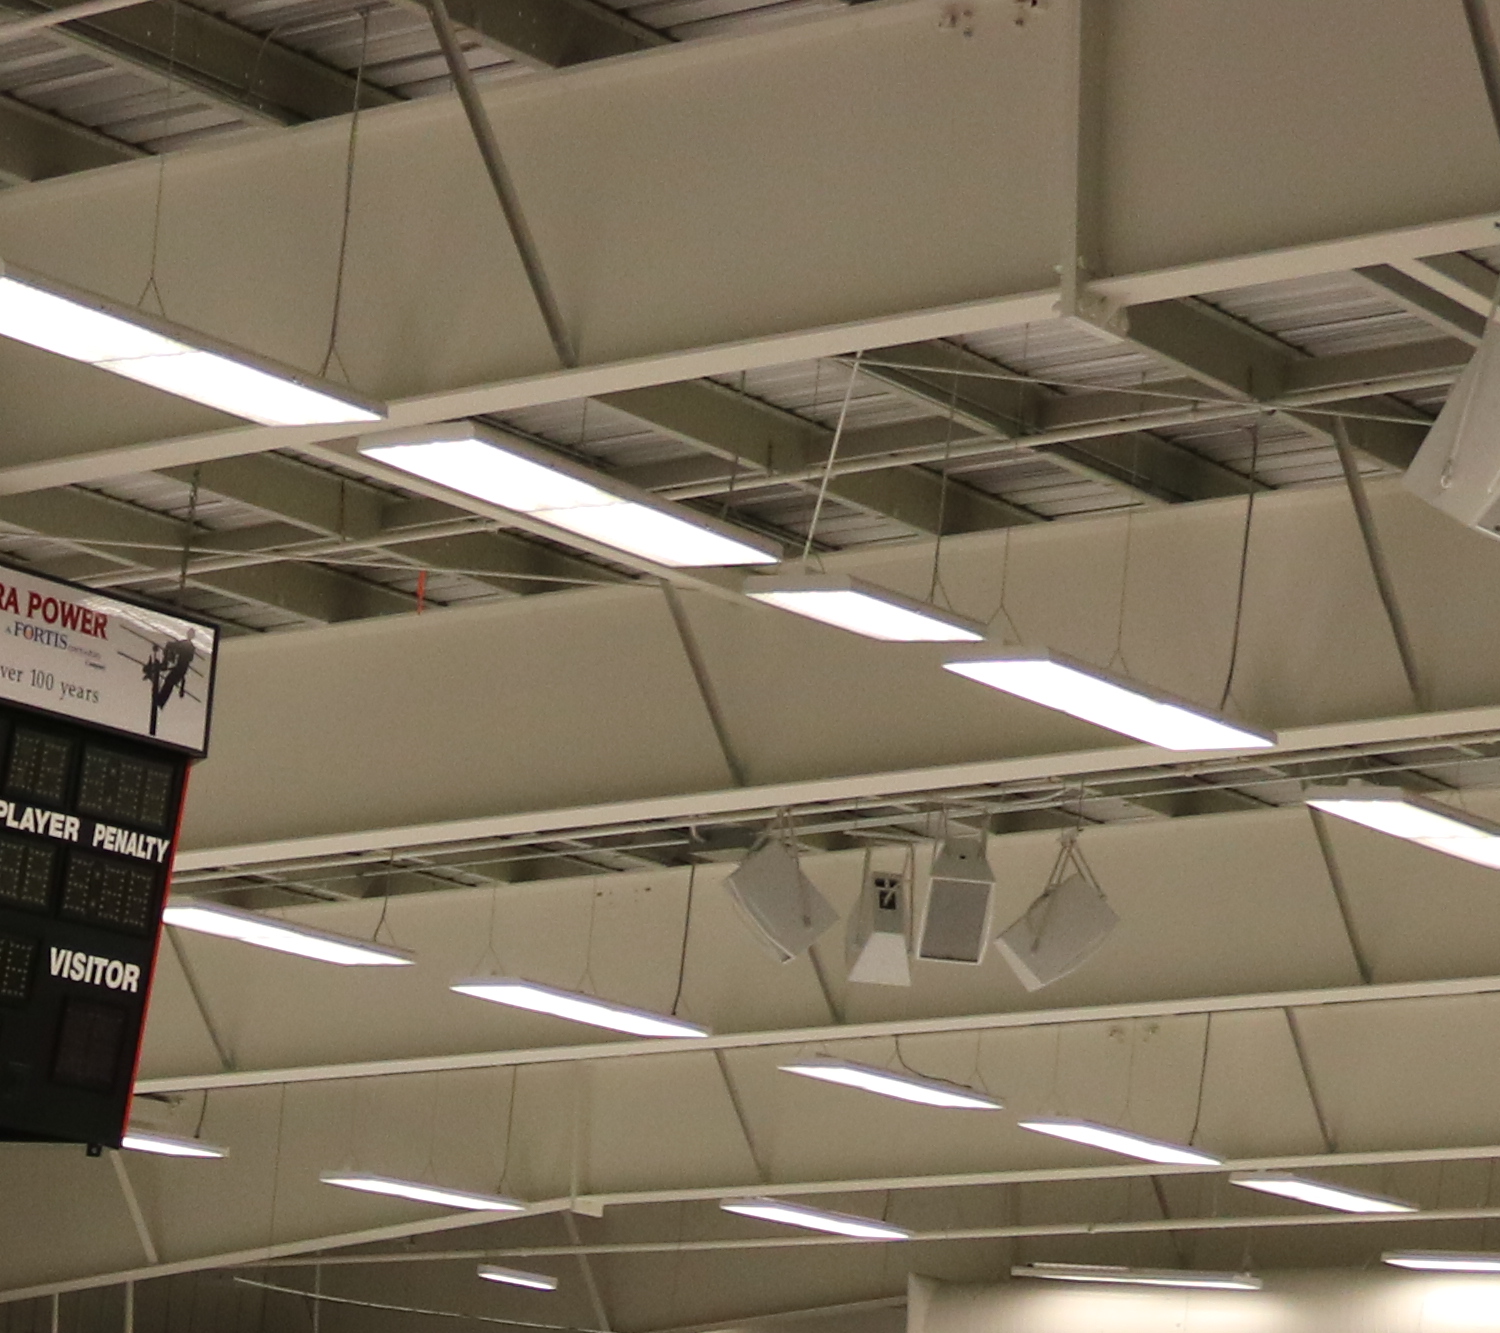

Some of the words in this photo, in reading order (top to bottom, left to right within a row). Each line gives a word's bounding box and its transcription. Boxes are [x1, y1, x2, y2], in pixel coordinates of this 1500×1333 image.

[14, 621, 68, 649] FORTIS
[28, 593, 110, 641] POWER
[30, 669, 54, 692] 100
[59, 679, 100, 704] years
[92, 823, 170, 864] PENALTY
[49, 947, 140, 993] VISITOR
